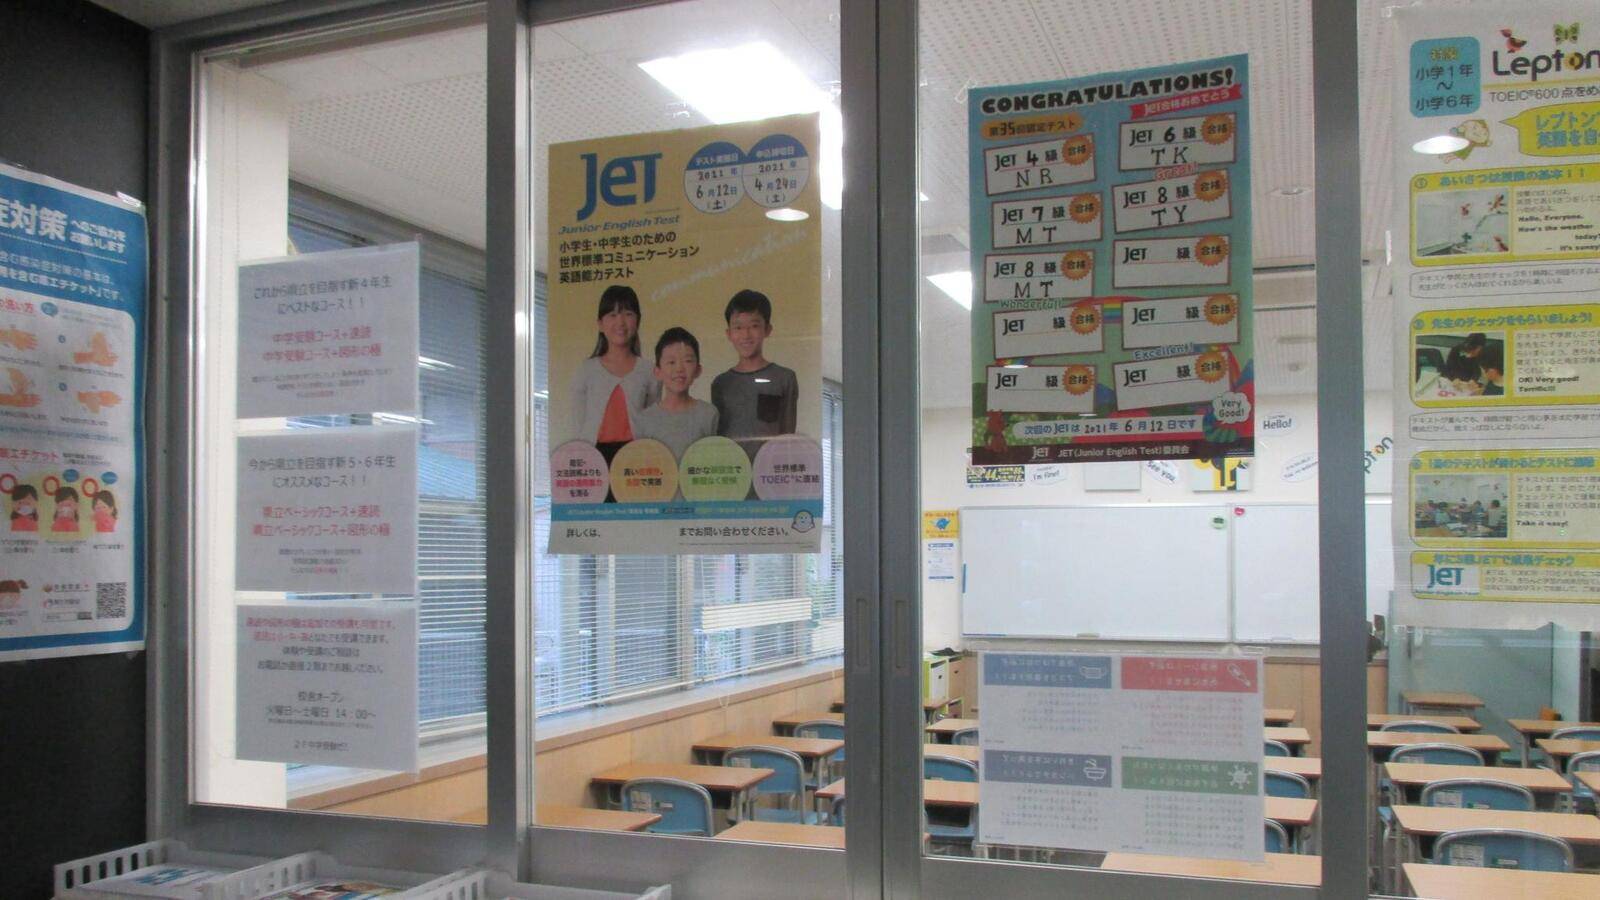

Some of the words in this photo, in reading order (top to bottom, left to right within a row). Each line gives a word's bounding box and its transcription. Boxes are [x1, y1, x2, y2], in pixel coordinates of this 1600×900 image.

[1416, 63, 1474, 81] 小学1年
[1492, 49, 1600, 81] Lepton
[982, 68, 1234, 114] CONGRATULATIONS!
[1416, 93, 1474, 111] 小学6年
[1164, 126, 1175, 143] 6
[1027, 150, 1039, 166] 4
[1158, 186, 1168, 204] 8
[1031, 206, 1044, 221] 7
[559, 224, 600, 235] Junior
[602, 218, 652, 231] English
[654, 215, 680, 226] Test
[560, 231, 677, 254] 小学生・中学生のための
[560, 246, 700, 269] 世界標準コミュニケーション
[559, 266, 635, 284] 英語能力テスト
[1024, 261, 1034, 278] 8
[1218, 408, 1245, 418] Good!
[1220, 399, 1242, 410] Very
[1262, 418, 1292, 430] Hello!
[1106, 446, 1138, 458] English
[679, 527, 790, 538] までお問い合わせください。
